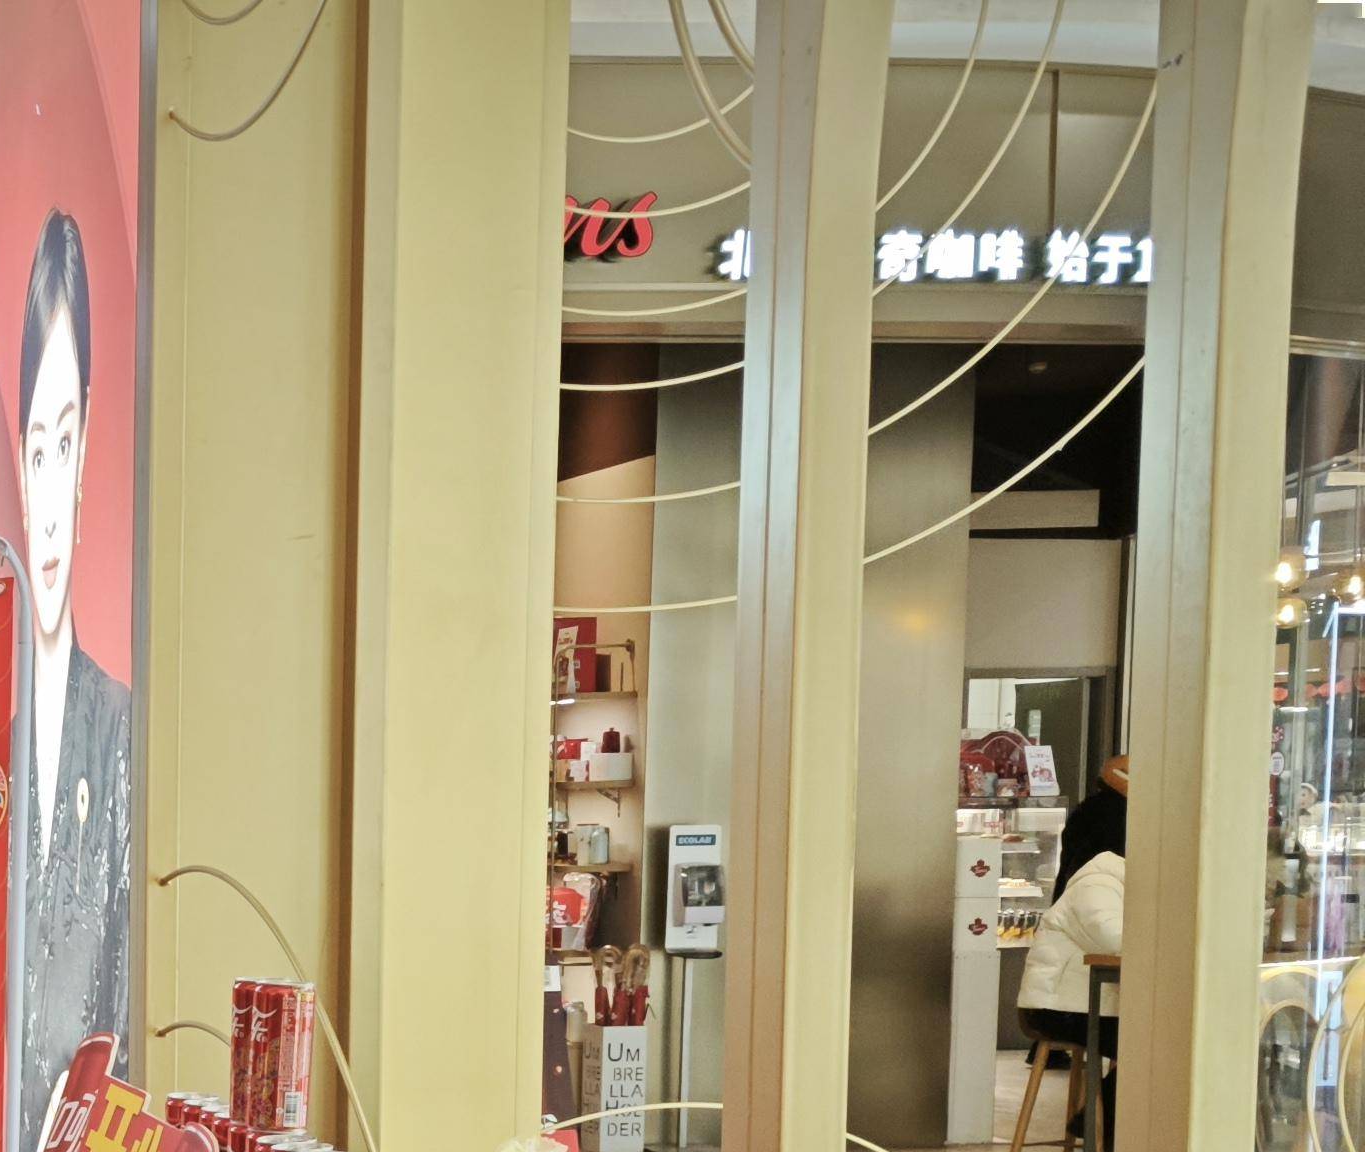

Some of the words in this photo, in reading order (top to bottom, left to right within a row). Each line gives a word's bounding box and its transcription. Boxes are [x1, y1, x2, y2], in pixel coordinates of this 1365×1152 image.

[677, 835, 714, 846] ECOLAB
[613, 1066, 645, 1081] BRE
[609, 1084, 644, 1098] LLA
[607, 1122, 642, 1137] DER
